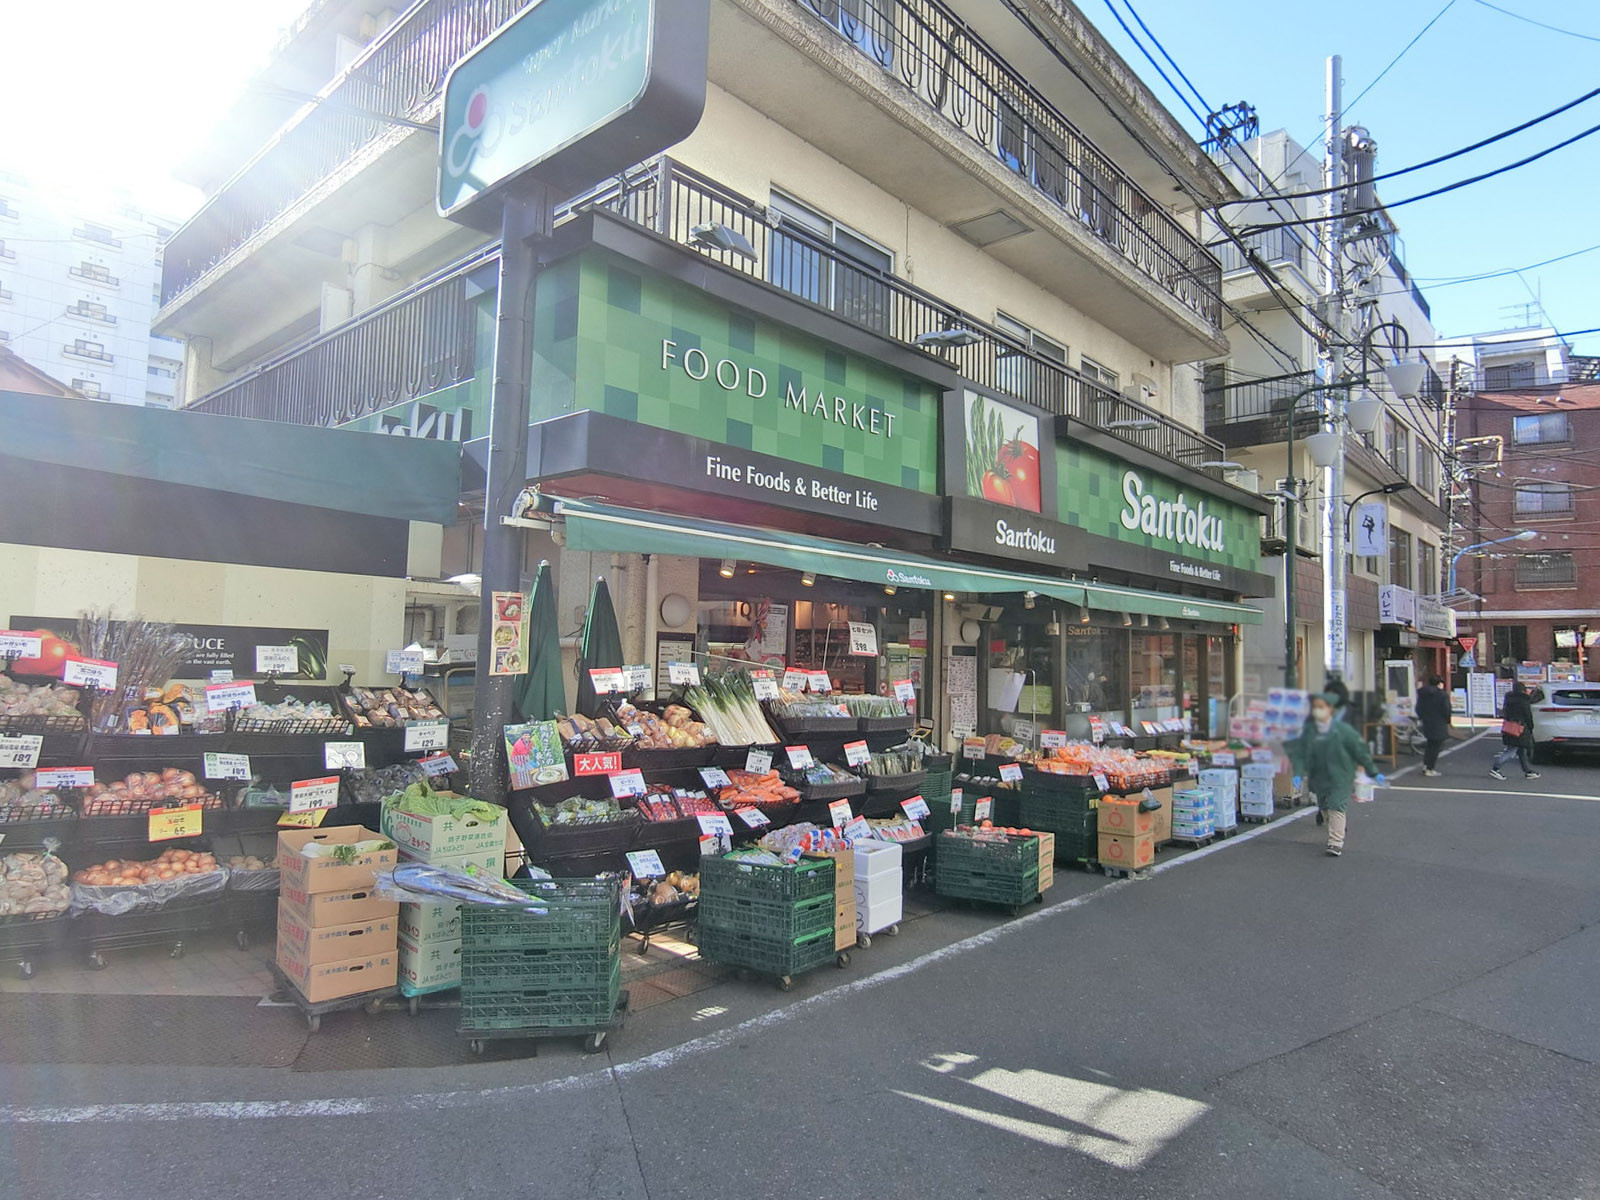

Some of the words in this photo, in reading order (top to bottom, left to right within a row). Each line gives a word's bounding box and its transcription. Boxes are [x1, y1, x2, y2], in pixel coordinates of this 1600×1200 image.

[661, 338, 769, 399] FOOD
[784, 381, 896, 438] MARKET
[706, 456, 742, 482] Fine
[747, 465, 791, 492] Foods
[794, 477, 807, 497] &
[811, 480, 852, 505] Better
[855, 490, 878, 511] Life
[1120, 470, 1225, 552] Santoku
[995, 519, 1056, 554] Santoku
[898, 572, 931, 586] Santoku
[1381, 590, 1392, 617] バレエ
[12, 753, 32, 762] 187
[579, 756, 617, 772] 大人気!
[309, 798, 323, 808] 197
[443, 821, 453, 832] 共
